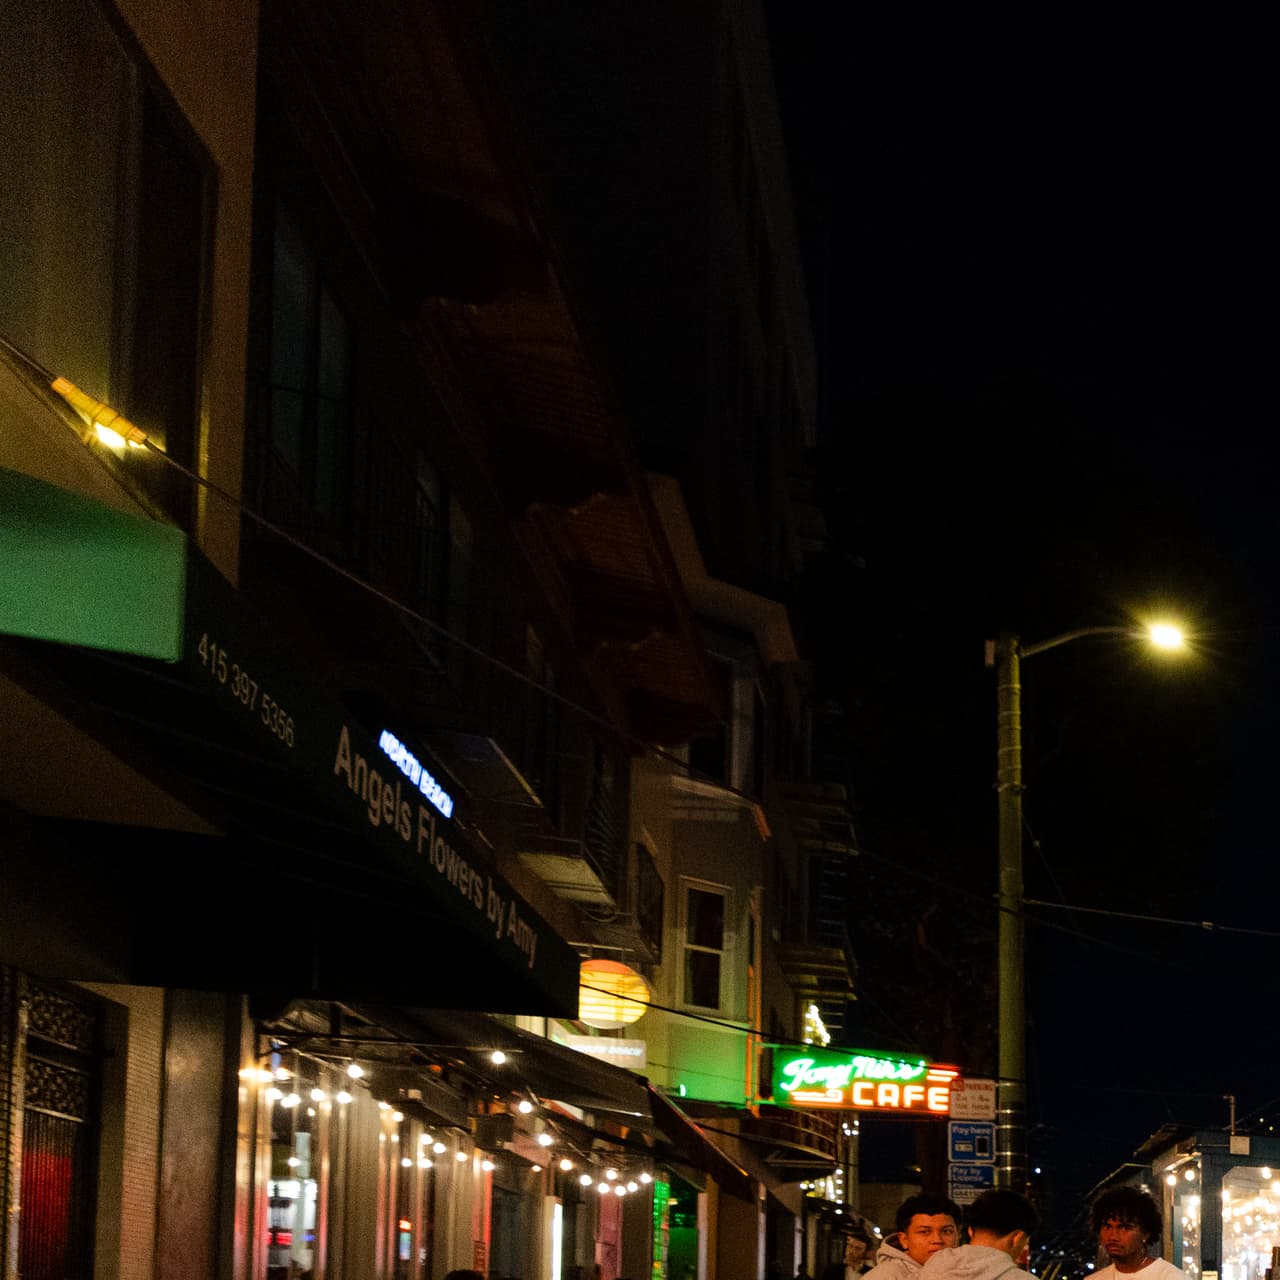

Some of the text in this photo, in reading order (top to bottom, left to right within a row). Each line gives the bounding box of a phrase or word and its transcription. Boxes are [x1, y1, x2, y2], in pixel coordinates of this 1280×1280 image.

[198, 632, 295, 748] 415 397 5356
[380, 729, 454, 818] NORTH BEACH
[334, 724, 538, 969] Angels Flowers by Amy
[779, 1058, 852, 1093] Tony
[853, 1081, 950, 1111] CAFE
[952, 1124, 993, 1137] Pay here
